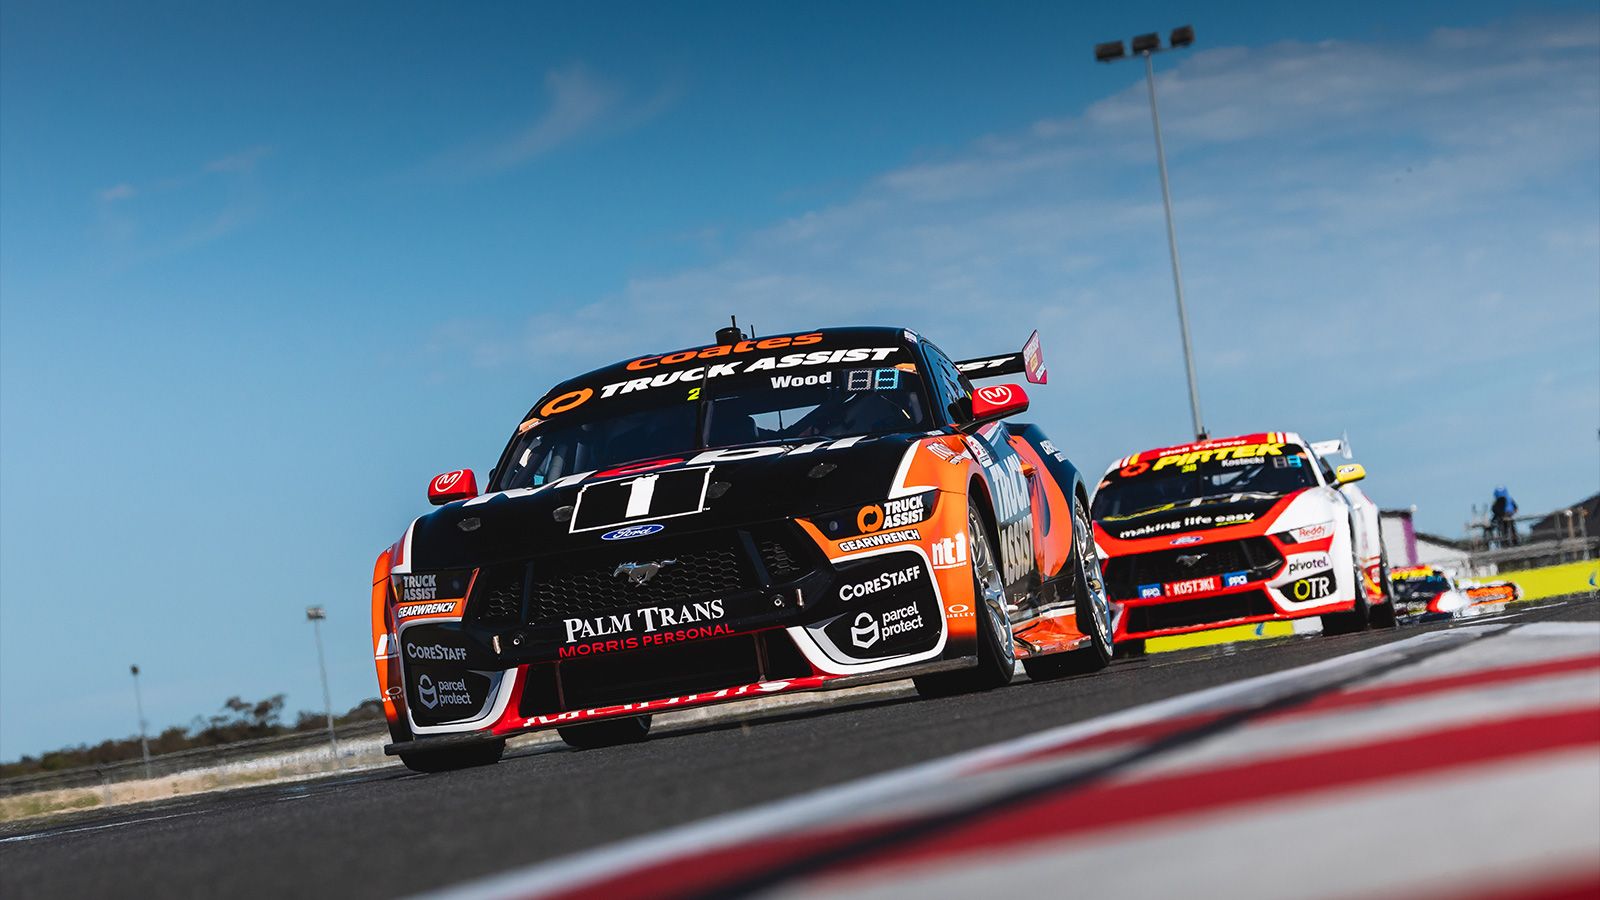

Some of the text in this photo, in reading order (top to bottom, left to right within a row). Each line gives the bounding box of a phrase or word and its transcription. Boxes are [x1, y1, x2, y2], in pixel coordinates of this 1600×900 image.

[625, 332, 823, 371] coates
[600, 347, 899, 399] TRUCK ASSIST
[771, 371, 832, 389] Wood
[1152, 443, 1285, 471] PIRTEK
[884, 495, 924, 515] TRUCK
[882, 508, 924, 529] ASSIST
[1120, 511, 1255, 539] making life easy
[613, 526, 653, 539] Ford
[839, 529, 921, 552] GEARWRENCH
[1001, 513, 1035, 586] ASSIST
[403, 574, 437, 588] TRUCK
[1294, 576, 1330, 600] OTR
[403, 587, 437, 601] ASSIST
[398, 601, 457, 618] GEARWRENCH
[563, 599, 725, 643] PALM TRANS
[882, 601, 919, 626] parcel
[881, 614, 924, 641] protect
[559, 623, 736, 658] MORRIS PERSONAL
[438, 678, 467, 693] parcel
[438, 692, 472, 707] protect
